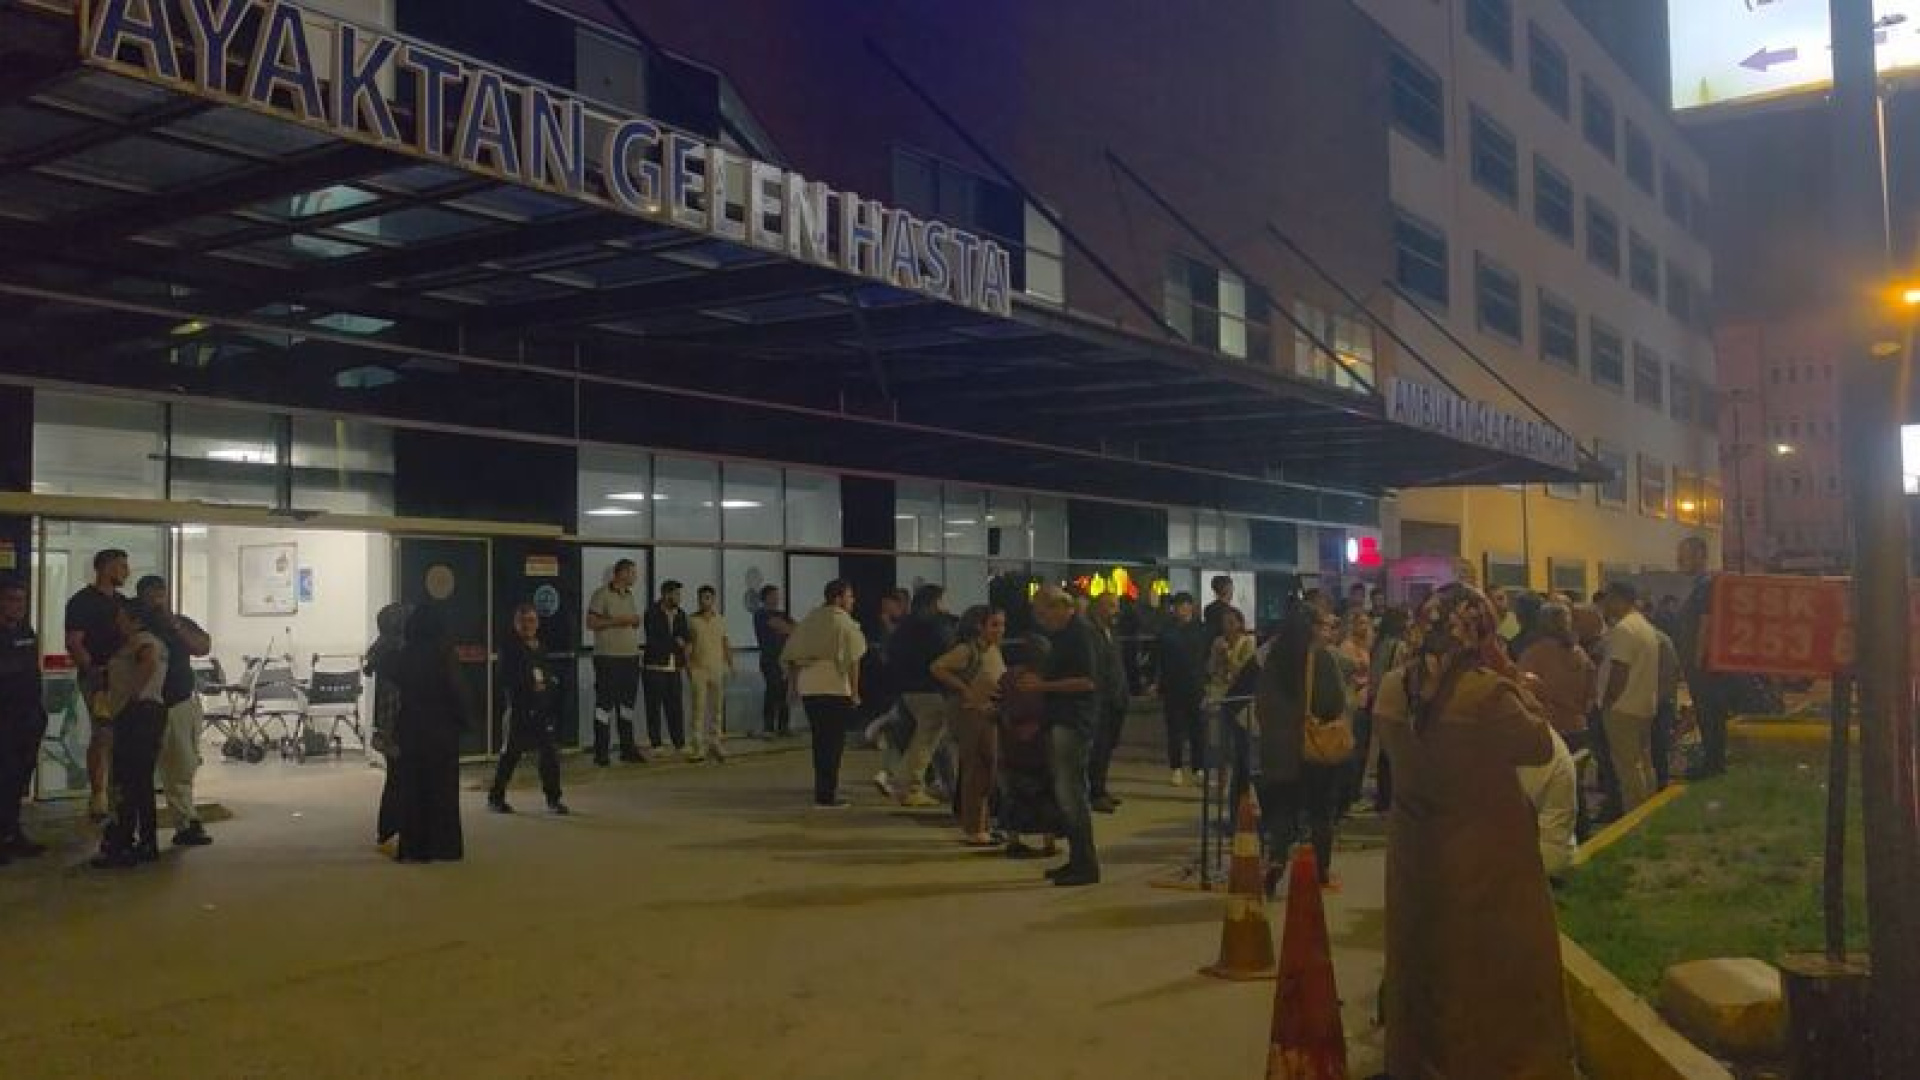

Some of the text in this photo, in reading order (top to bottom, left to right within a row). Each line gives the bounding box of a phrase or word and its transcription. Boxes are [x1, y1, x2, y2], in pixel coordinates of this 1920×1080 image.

[87, 0, 1012, 318] AYAKTAN GELEN HASTA
[1730, 586, 1815, 616] SSK
[1728, 619, 1812, 659] 253
